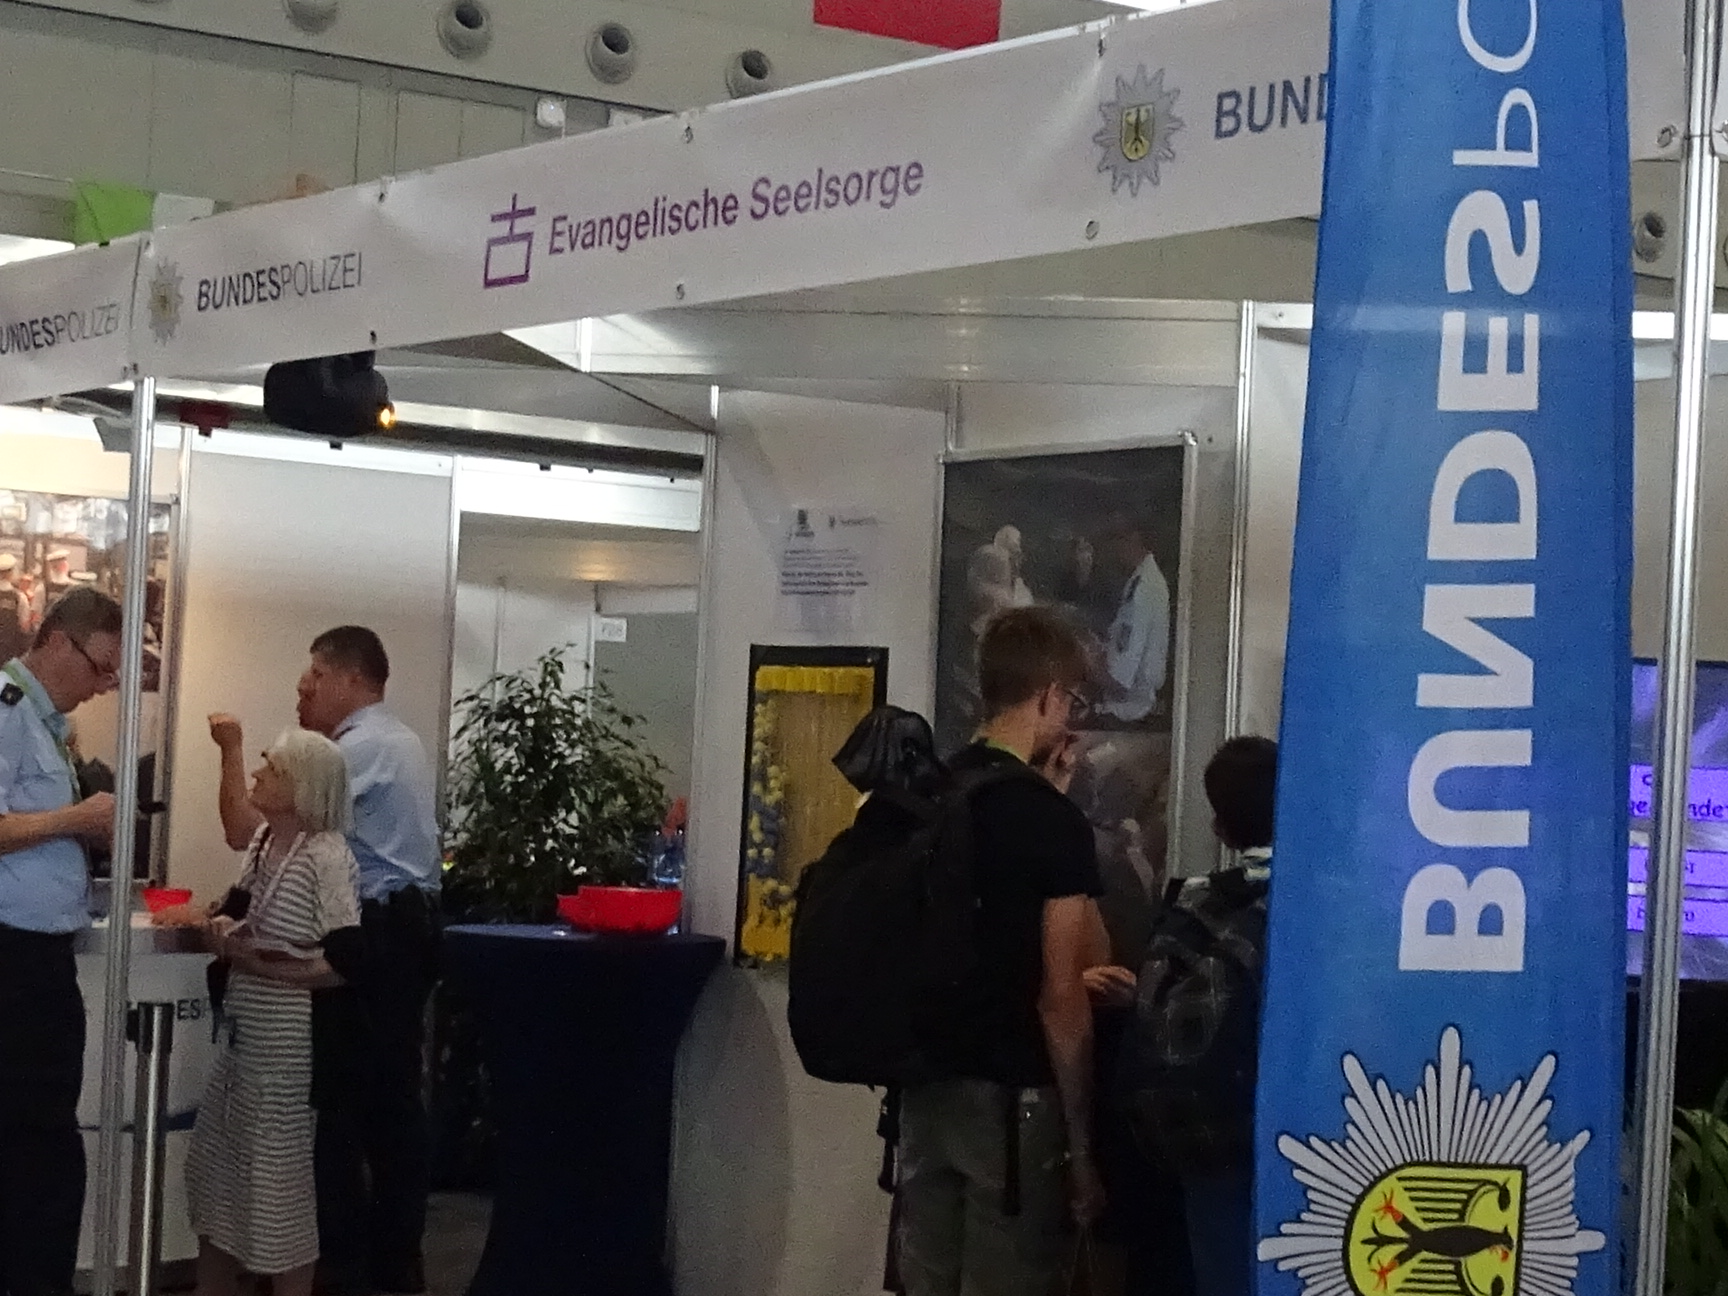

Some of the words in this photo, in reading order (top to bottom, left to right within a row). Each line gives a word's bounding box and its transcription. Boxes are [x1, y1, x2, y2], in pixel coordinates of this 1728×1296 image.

[548, 188, 739, 258] Evangelische
[749, 157, 925, 222] Seelsorge
[197, 252, 363, 313] BUNDESPOLIZEI
